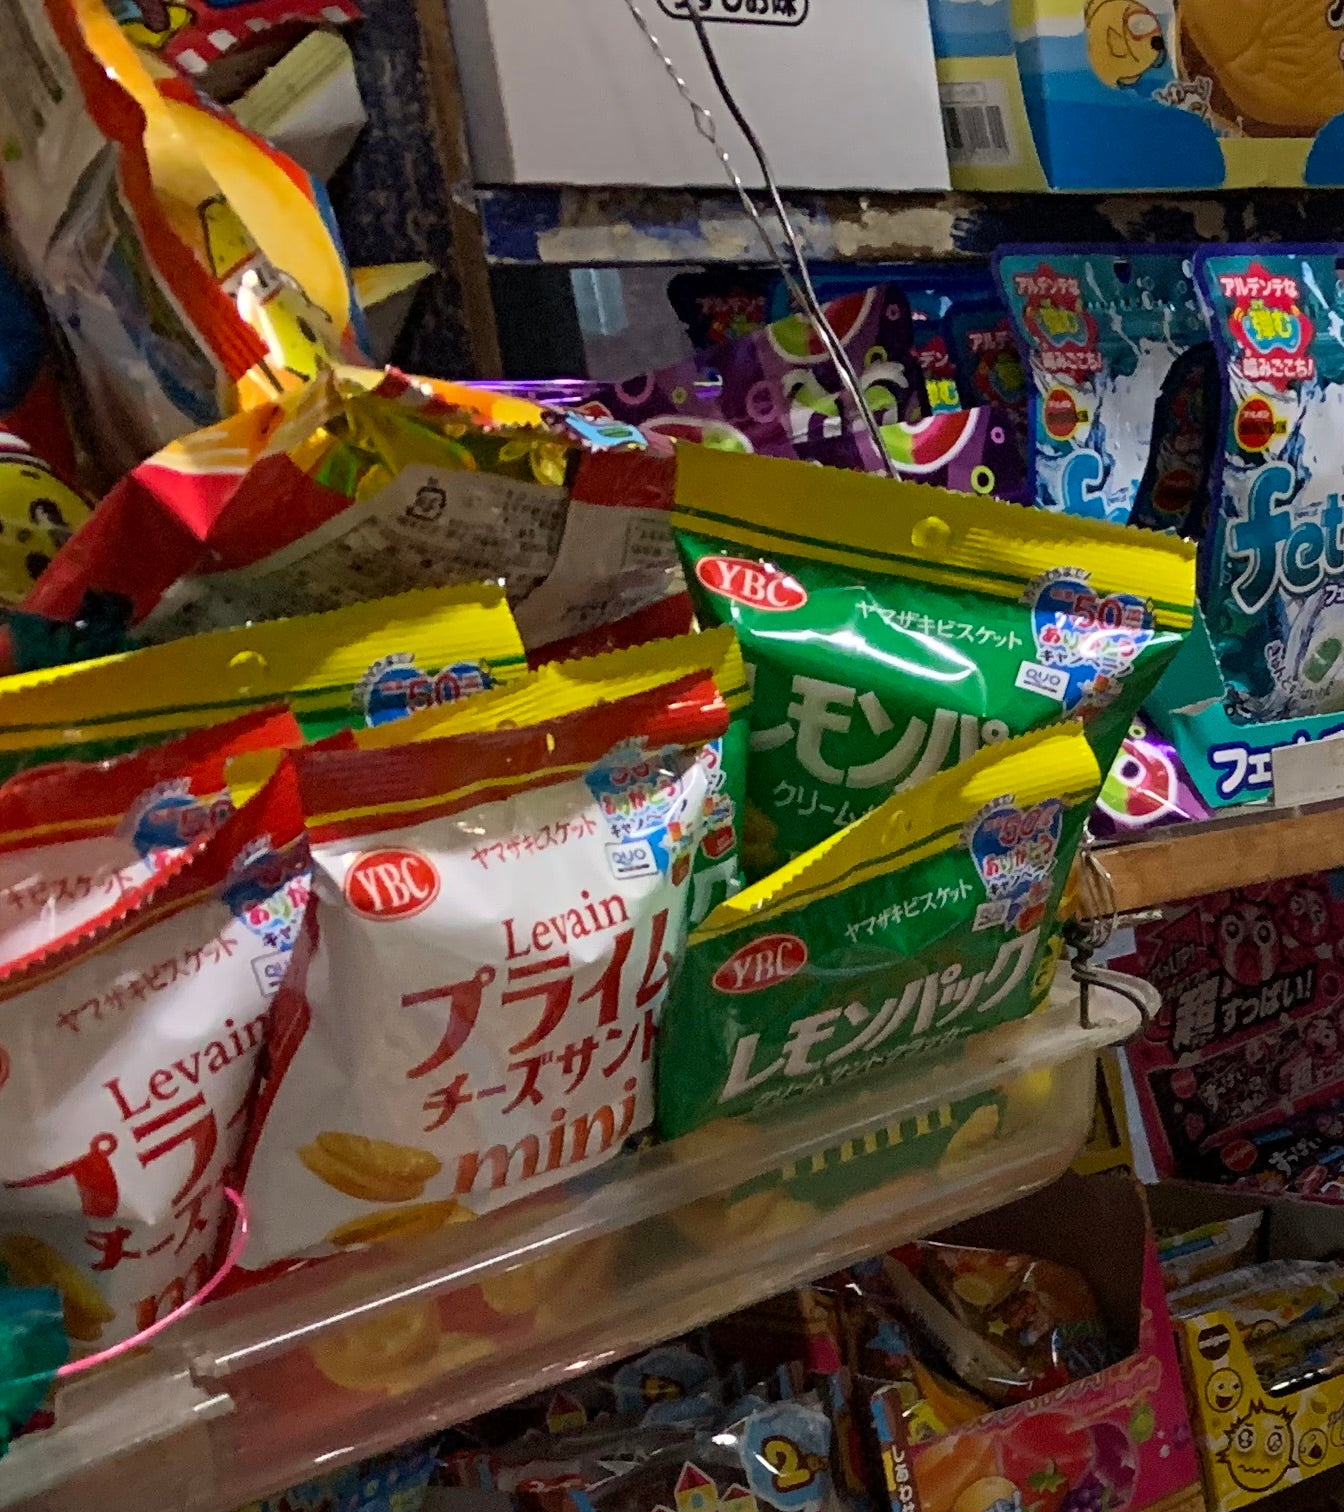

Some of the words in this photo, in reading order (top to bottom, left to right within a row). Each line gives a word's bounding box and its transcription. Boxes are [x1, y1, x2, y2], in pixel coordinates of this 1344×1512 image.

[1016, 276, 1080, 297] アルデンテな
[1220, 276, 1299, 298] アルデンテな
[1243, 357, 1314, 378] 噛みここち!
[712, 556, 793, 608] YBC
[855, 599, 1023, 651] ヤマザキビスケット
[1025, 667, 1062, 688] QUO
[469, 812, 598, 872] ヤマザキビスケット
[357, 856, 433, 913] YBC
[844, 878, 974, 939] ヤマザキビスケット
[501, 888, 631, 962] Levain
[57, 933, 239, 1031] ヤマザキビスケット
[728, 939, 794, 984] YBC
[400, 906, 672, 1080] プライム
[716, 927, 1040, 1104] レモンパック
[103, 1015, 269, 1120] Levain
[450, 1078, 639, 1198] mini
